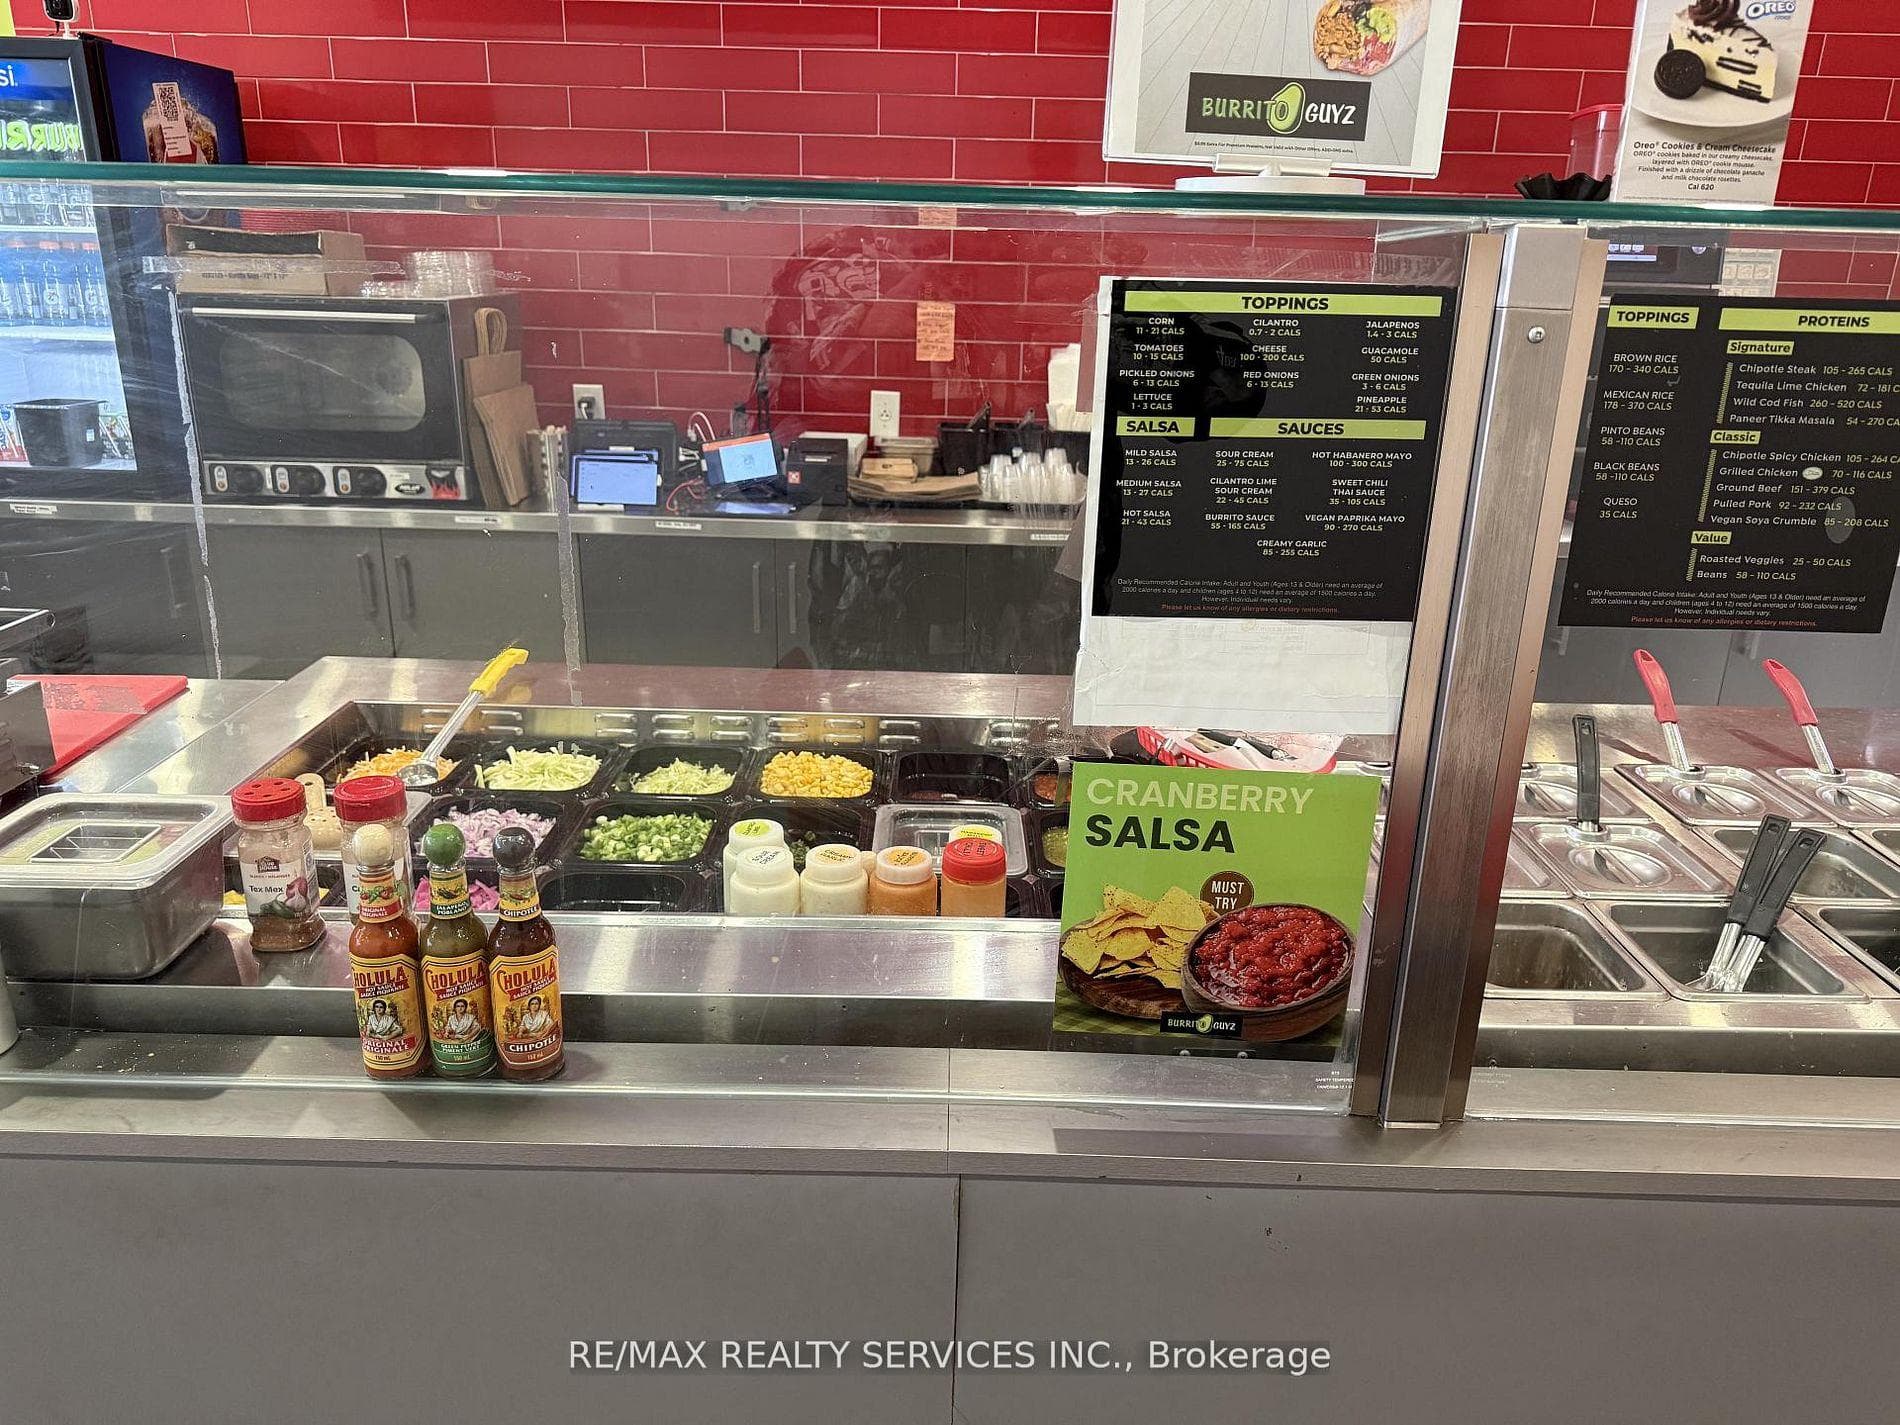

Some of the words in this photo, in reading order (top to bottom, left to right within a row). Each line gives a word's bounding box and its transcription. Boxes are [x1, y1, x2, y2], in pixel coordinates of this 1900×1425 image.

[1746, 1, 1796, 19] OREO
[1305, 102, 1355, 124] GUYZ
[1661, 142, 1694, 150] Cookies
[1705, 143, 1729, 151] Cream
[1733, 144, 1776, 153] Cheesecake
[1242, 297, 1329, 310] TOPPINGS
[1617, 312, 1690, 323] TOPPINGS
[1798, 316, 1870, 327] PROTEINS
[1253, 319, 1299, 327] CILANTRO
[1366, 321, 1420, 329] JALAPENOS
[1134, 344, 1184, 352] TOMATOES
[1361, 347, 1419, 355] GUACAMOLE
[1730, 342, 1790, 354] Signature
[1384, 356, 1407, 364] CALS
[1614, 354, 1652, 363] BROWN
[1655, 355, 1677, 363] RICE
[1740, 364, 1784, 374] Chipotle
[1787, 365, 1816, 374] Steak
[1119, 370, 1158, 378] PICKLED
[1160, 370, 1195, 378] ONIONS
[1244, 371, 1262, 379] RED
[1352, 373, 1382, 381] GREEN
[1384, 373, 1419, 382] ONIONS
[1736, 382, 1775, 393] Tequila
[1777, 382, 1802, 391] Lime
[1805, 383, 1847, 392] Chicken
[1133, 393, 1172, 401] LETTUCE
[1357, 396, 1407, 404] PINEAPPLE
[1603, 391, 1648, 400] MEXICAN
[1650, 391, 1675, 400] RICE
[1733, 398, 1757, 407] Wild
[1759, 398, 1780, 407] Cod
[1783, 399, 1804, 408] Fish
[1730, 414, 1767, 424] Paneer
[1769, 415, 1796, 424] Tikka
[1799, 416, 1835, 425] Masala
[1126, 421, 1179, 433] SALSA
[1278, 423, 1344, 435] SAUCES
[1601, 427, 1630, 436] PINTO
[1633, 427, 1665, 436] BEANS
[1714, 432, 1756, 442] Classic
[1616, 438, 1634, 446] -110
[1636, 438, 1661, 446] CALS
[1125, 449, 1147, 457] MILD
[1149, 450, 1178, 458] SALSA
[1312, 451, 1331, 459] HOT
[1333, 452, 1382, 460] HABANERO
[1385, 452, 1412, 460] MAYO
[1723, 452, 1767, 462] Chipotle
[1769, 452, 1797, 462] Spicy
[1800, 452, 1841, 462] Chicken
[1594, 462, 1626, 471] BLACK
[1628, 462, 1660, 471] BEANS
[1719, 468, 1758, 477] Grilled
[1758, 468, 1798, 477] Chicken
[1154, 480, 1182, 488] SALSA
[1210, 477, 1254, 485] CILANTRO
[1332, 479, 1361, 487] SWEET
[1363, 479, 1388, 487] CHILI
[1215, 487, 1238, 495] SOUR
[1333, 488, 1353, 496] THAI
[1716, 483, 1756, 492] Ground
[1758, 484, 1782, 493] Beef
[1603, 497, 1637, 506] QUESO
[1713, 499, 1744, 509] Pulled
[1746, 500, 1772, 509] Pork
[1123, 510, 1141, 518] HOT
[1143, 510, 1171, 518] SALSA
[1205, 513, 1244, 522] BURRITO
[1246, 514, 1275, 522] SAUCE
[1305, 514, 1335, 522] VEGAN
[1338, 515, 1376, 523] PAPRIKA
[1378, 515, 1405, 523] MAYO
[1600, 510, 1612, 518] 35
[1613, 511, 1637, 519] CALS
[1710, 516, 1743, 525] Vegan
[1745, 516, 1771, 526] Soya
[1774, 517, 1817, 526] Crumble
[1694, 533, 1728, 543] Value
[1257, 539, 1293, 548] CREAMY
[1295, 540, 1327, 548] GARLIC
[1700, 555, 1741, 564] Roasted
[1744, 556, 1784, 566] Veggies
[1697, 570, 1728, 579] Beans
[1087, 778, 1314, 814] CRANBERRY
[1085, 814, 1235, 853] SALSA
[1211, 881, 1245, 895] MUST
[1214, 896, 1238, 910] TRY
[503, 905, 537, 916] CHIPOTLE
[425, 962, 486, 991] CHOLULA
[497, 960, 556, 993] CHOLULA
[1168, 1018, 1207, 1029] BURRITO
[1213, 1021, 1236, 1031] GUYZ
[509, 1035, 557, 1051] CHIPOTLE
